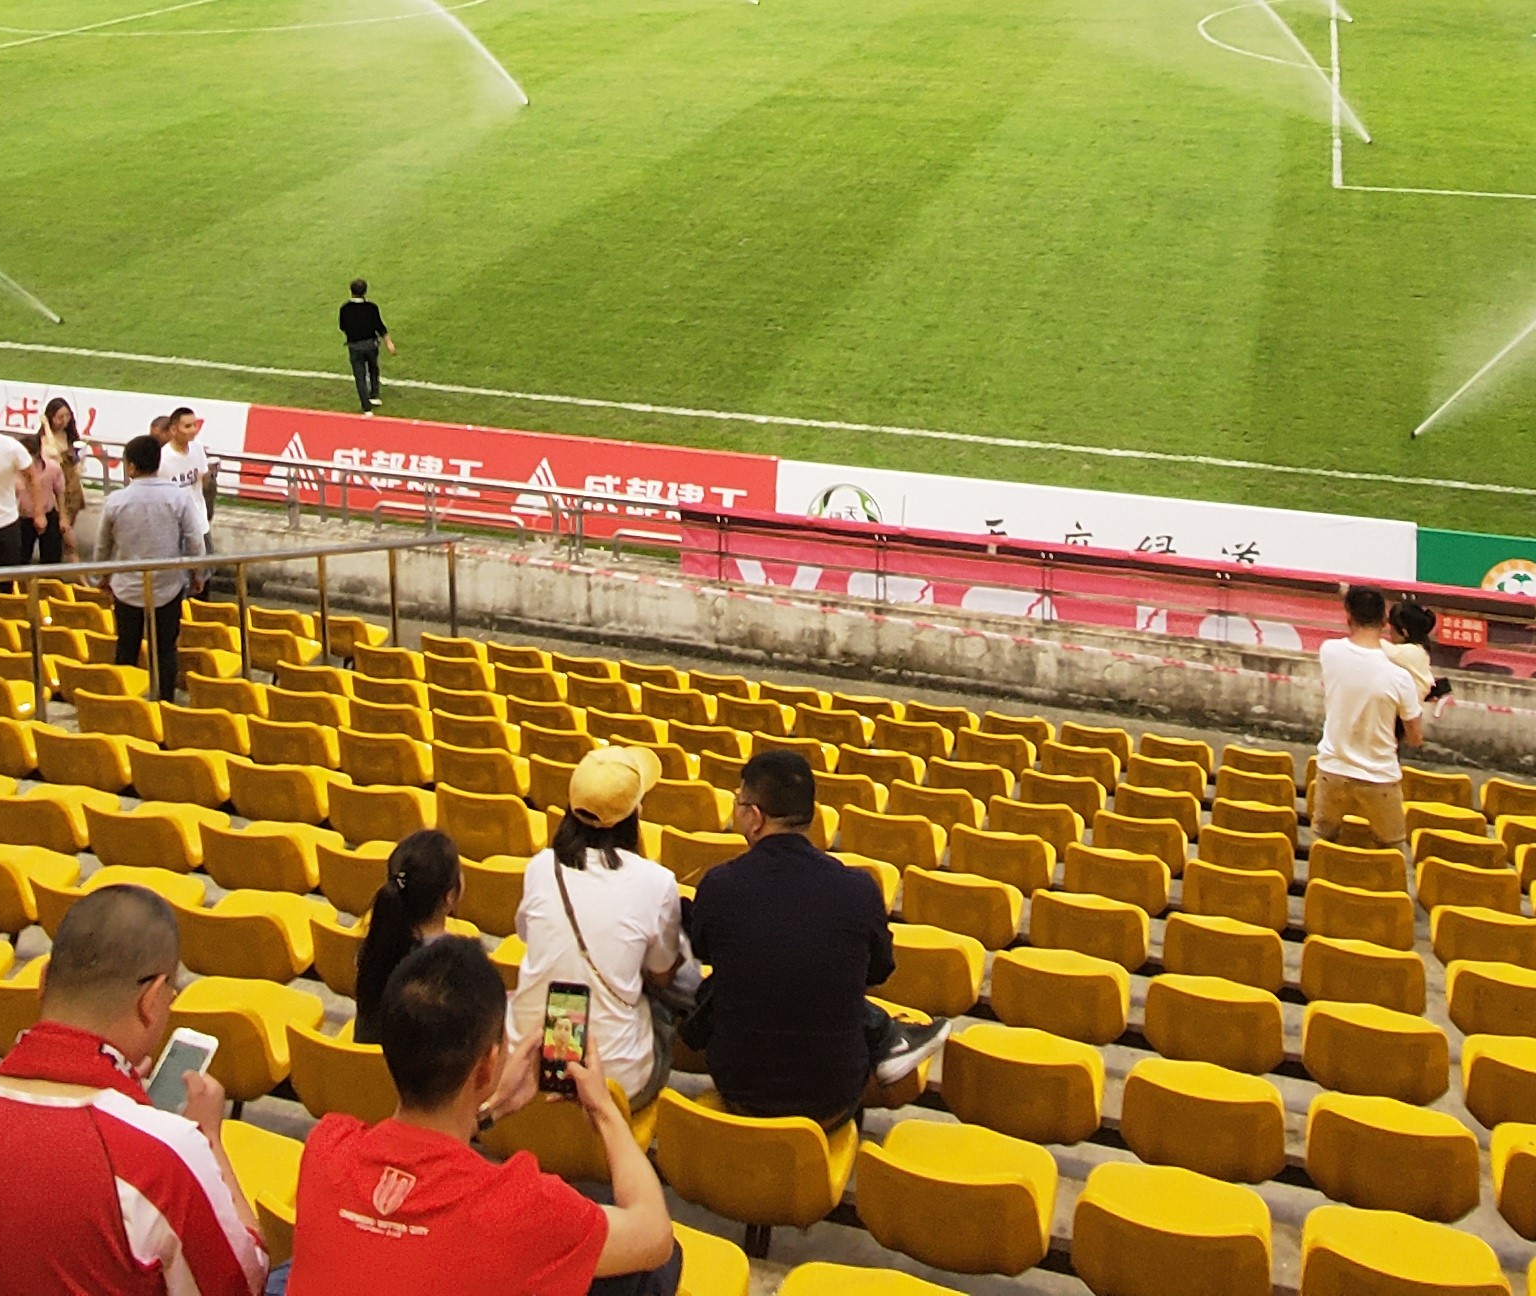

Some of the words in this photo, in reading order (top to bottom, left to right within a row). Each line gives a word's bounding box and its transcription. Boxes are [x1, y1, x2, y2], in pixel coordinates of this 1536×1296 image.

[332, 447, 484, 497] 成都建工
[582, 474, 748, 522] 成都建工
